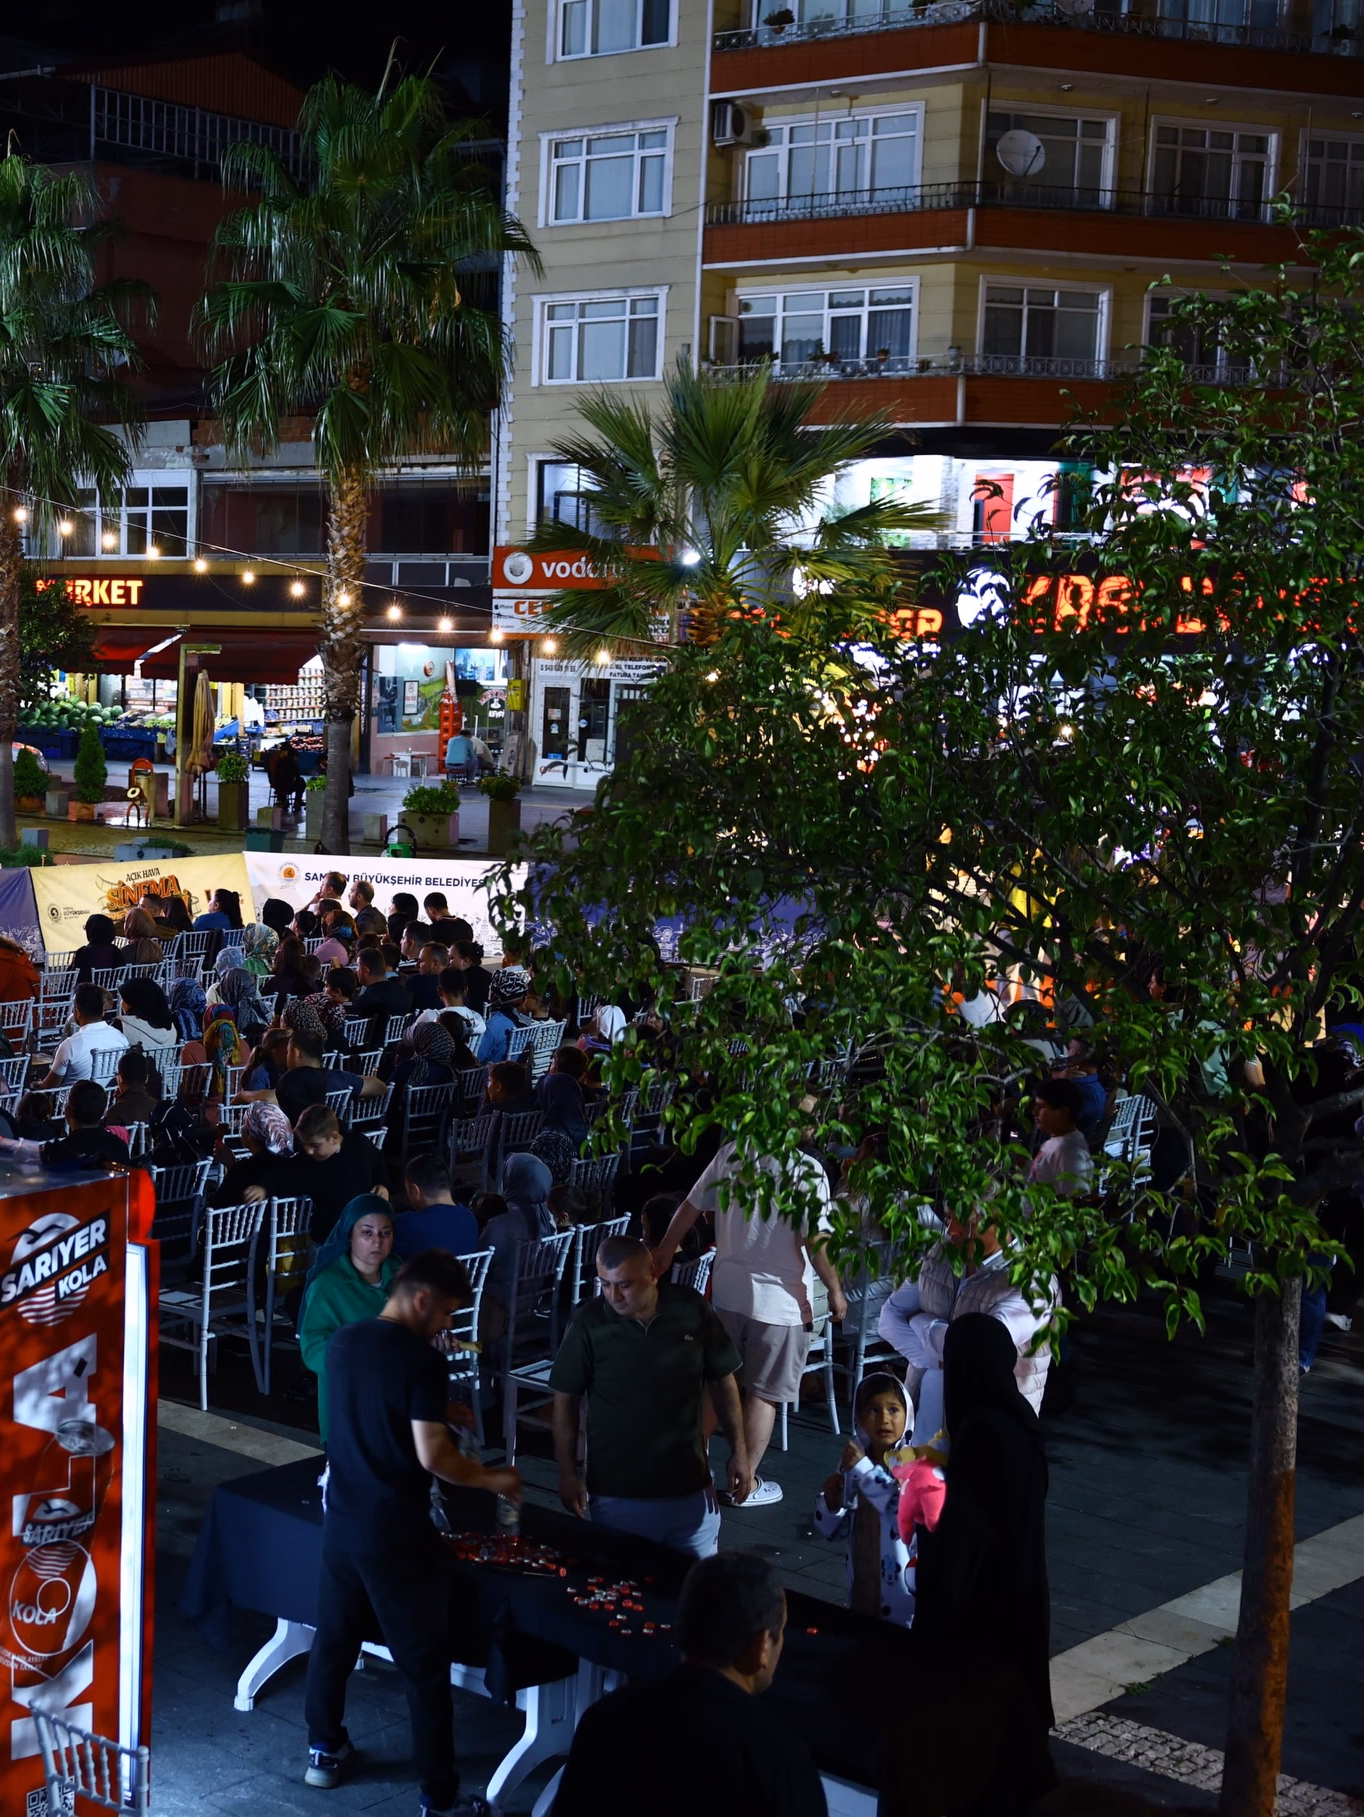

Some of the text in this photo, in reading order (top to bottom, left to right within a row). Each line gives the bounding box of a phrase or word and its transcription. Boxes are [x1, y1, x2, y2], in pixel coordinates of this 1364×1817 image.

[125, 867, 161, 884] AÇIK HAVA
[304, 871, 486, 888] SAMN BÜYÜKŞEHİR BELEDİYES
[107, 874, 180, 912] SİNEMA
[0, 1217, 107, 1304] SARIYER
[57, 1253, 108, 1300] KOLA
[12, 1600, 58, 1626] KOLA
